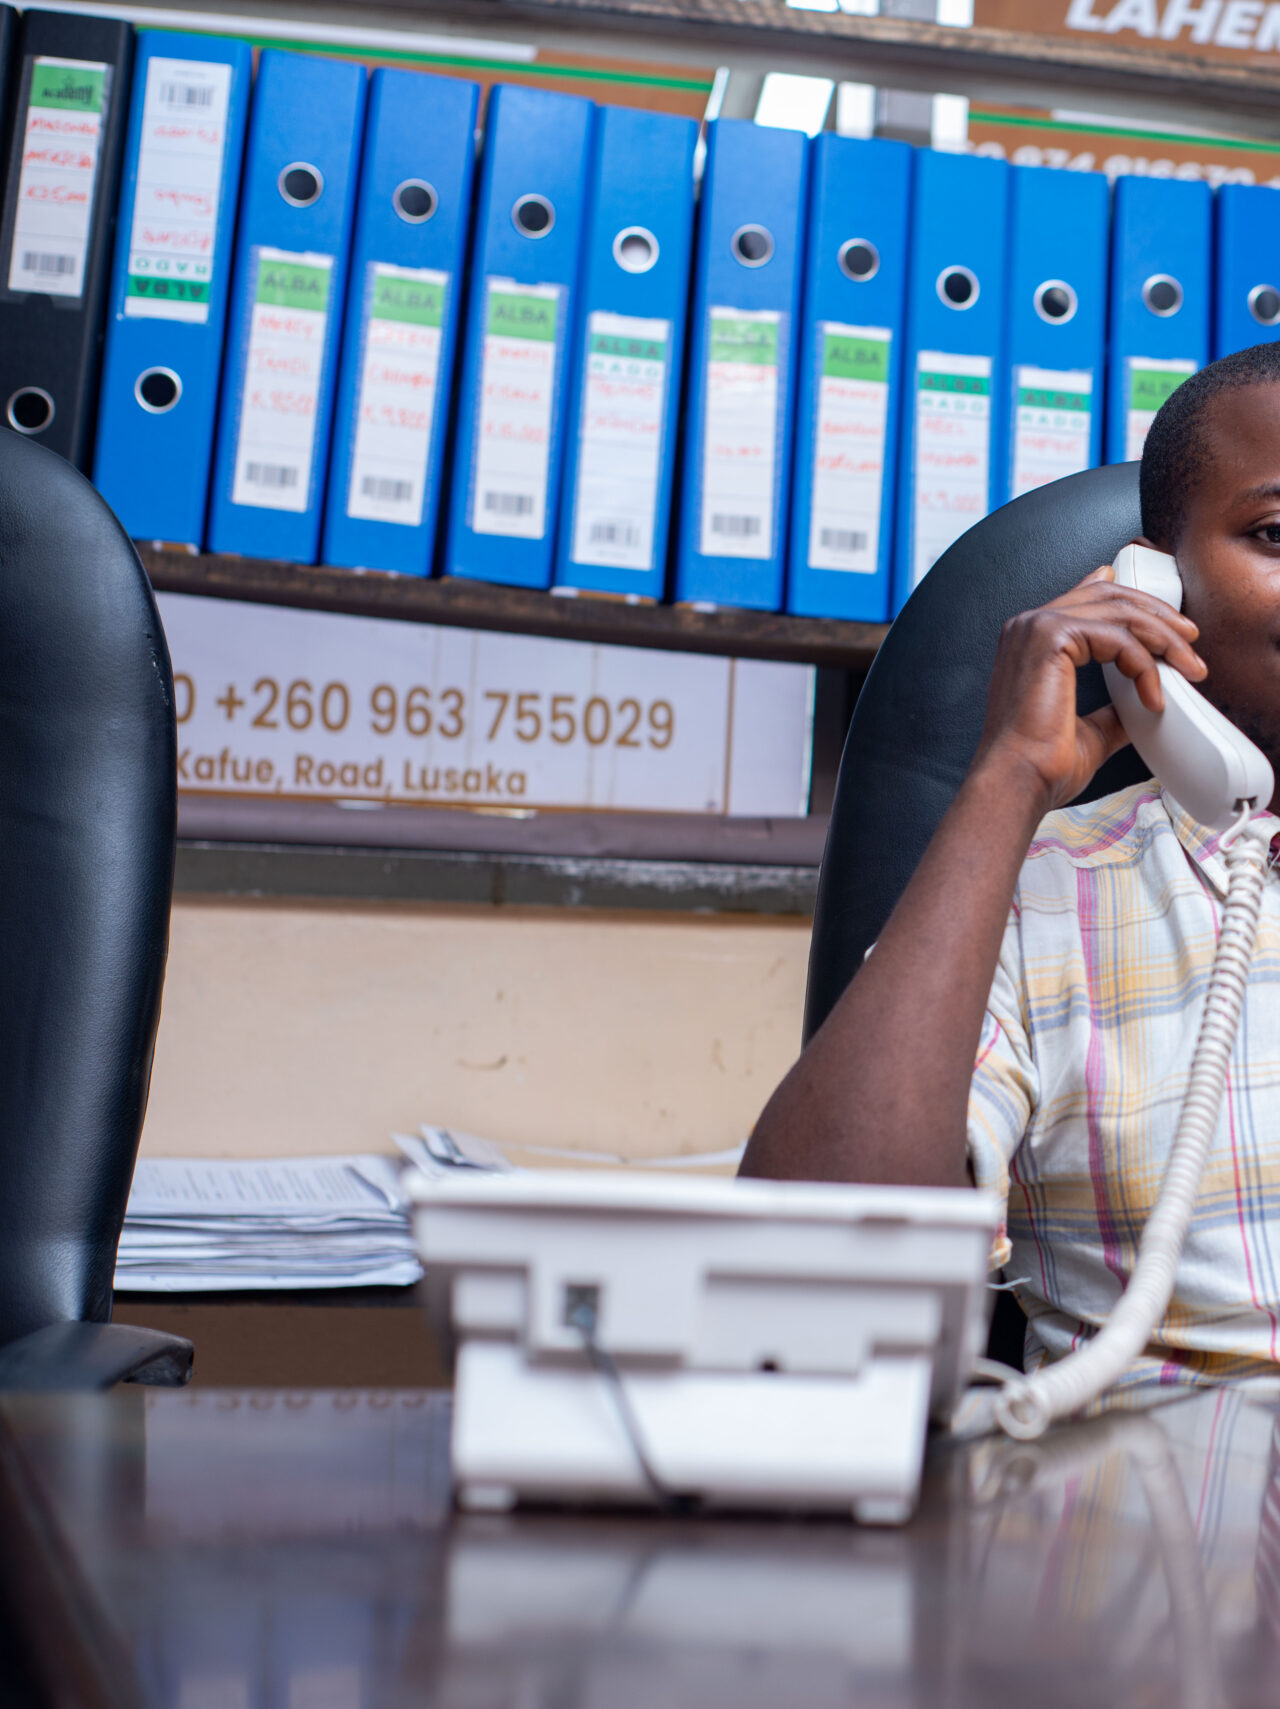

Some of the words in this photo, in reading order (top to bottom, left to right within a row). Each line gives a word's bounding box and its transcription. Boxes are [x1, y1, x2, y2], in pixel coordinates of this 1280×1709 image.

[135, 278, 204, 298] ALBA
[264, 271, 321, 295] ALBA
[381, 286, 436, 310] ALBA
[494, 303, 547, 325] ALBA
[596, 338, 659, 357] ALBA
[828, 345, 881, 366] ALBA
[924, 376, 984, 393] ALBA
[1137, 380, 1175, 396] ALB
[1024, 393, 1084, 409] ALBA
[217, 678, 351, 732] +260
[370, 684, 465, 739] 963
[484, 692, 675, 749] 755029
[295, 753, 392, 801] Road,
[403, 758, 527, 795] Lusaka
